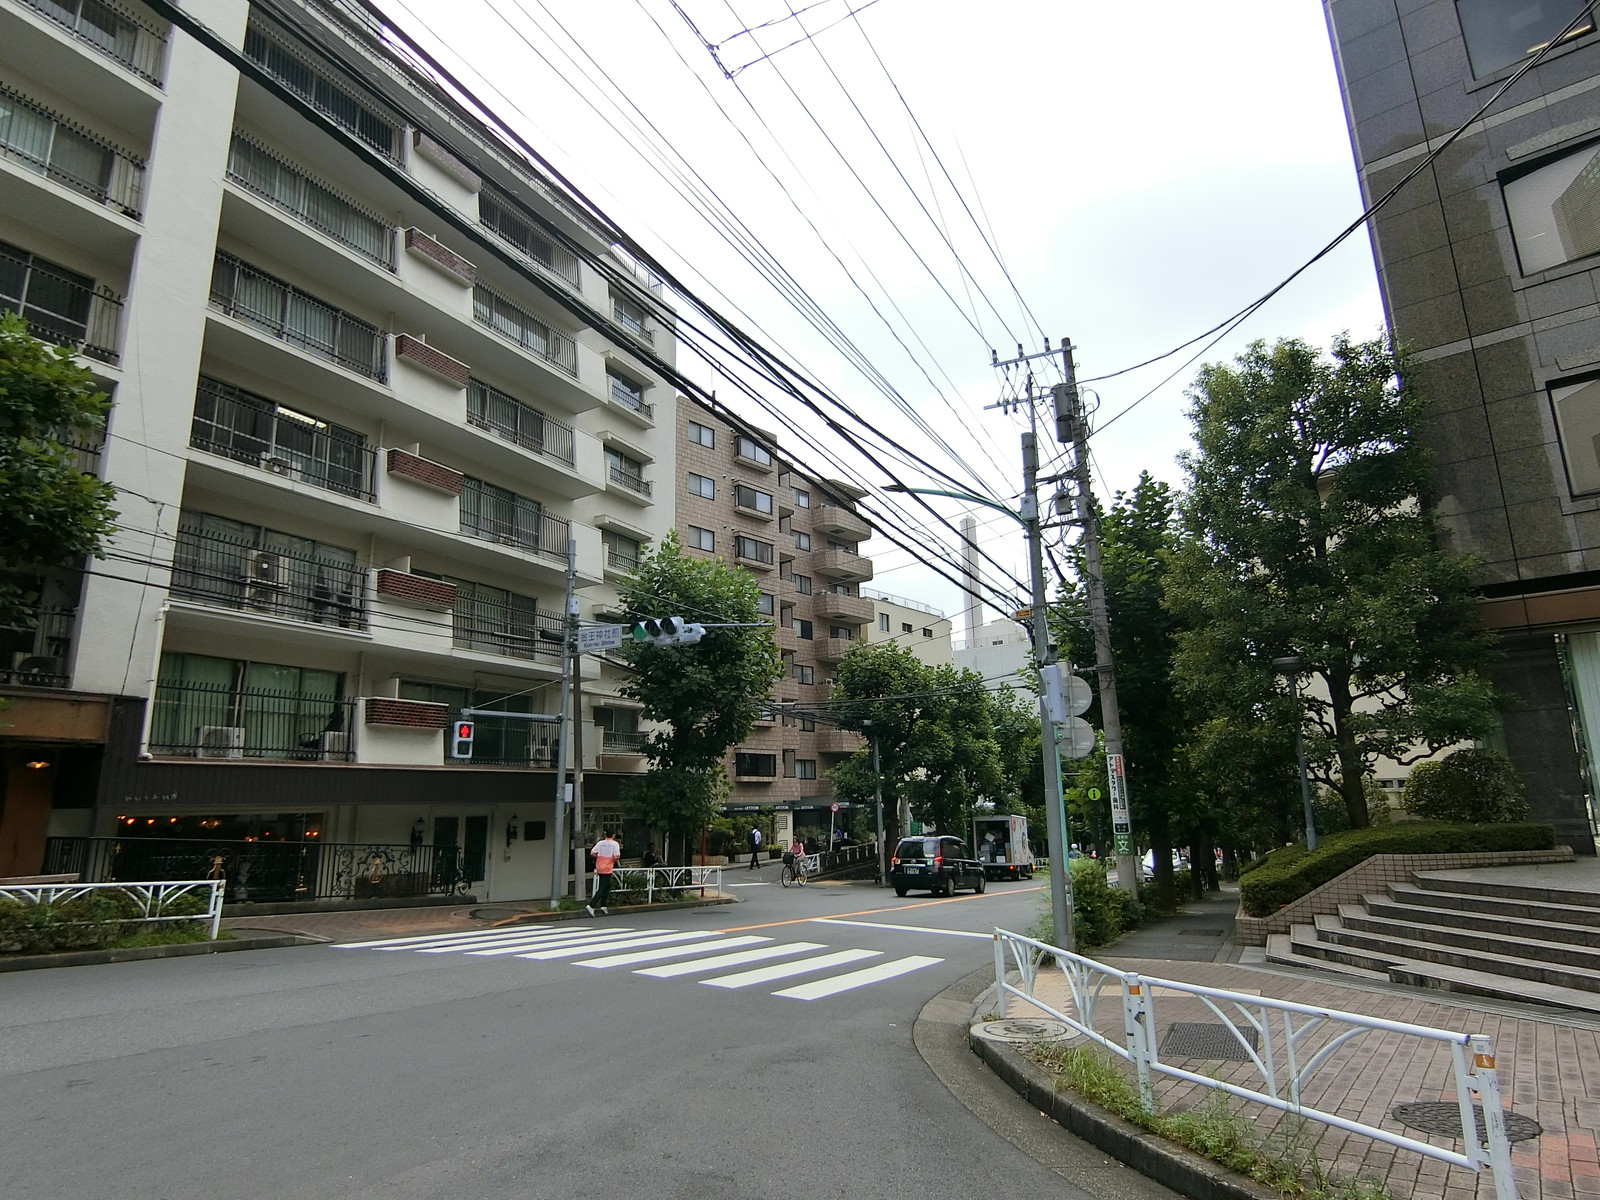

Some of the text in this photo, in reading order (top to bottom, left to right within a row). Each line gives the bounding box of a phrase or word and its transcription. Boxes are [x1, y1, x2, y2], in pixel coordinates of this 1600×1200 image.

[581, 628, 619, 642] 金王神社前
[1117, 840, 1130, 852] 文
